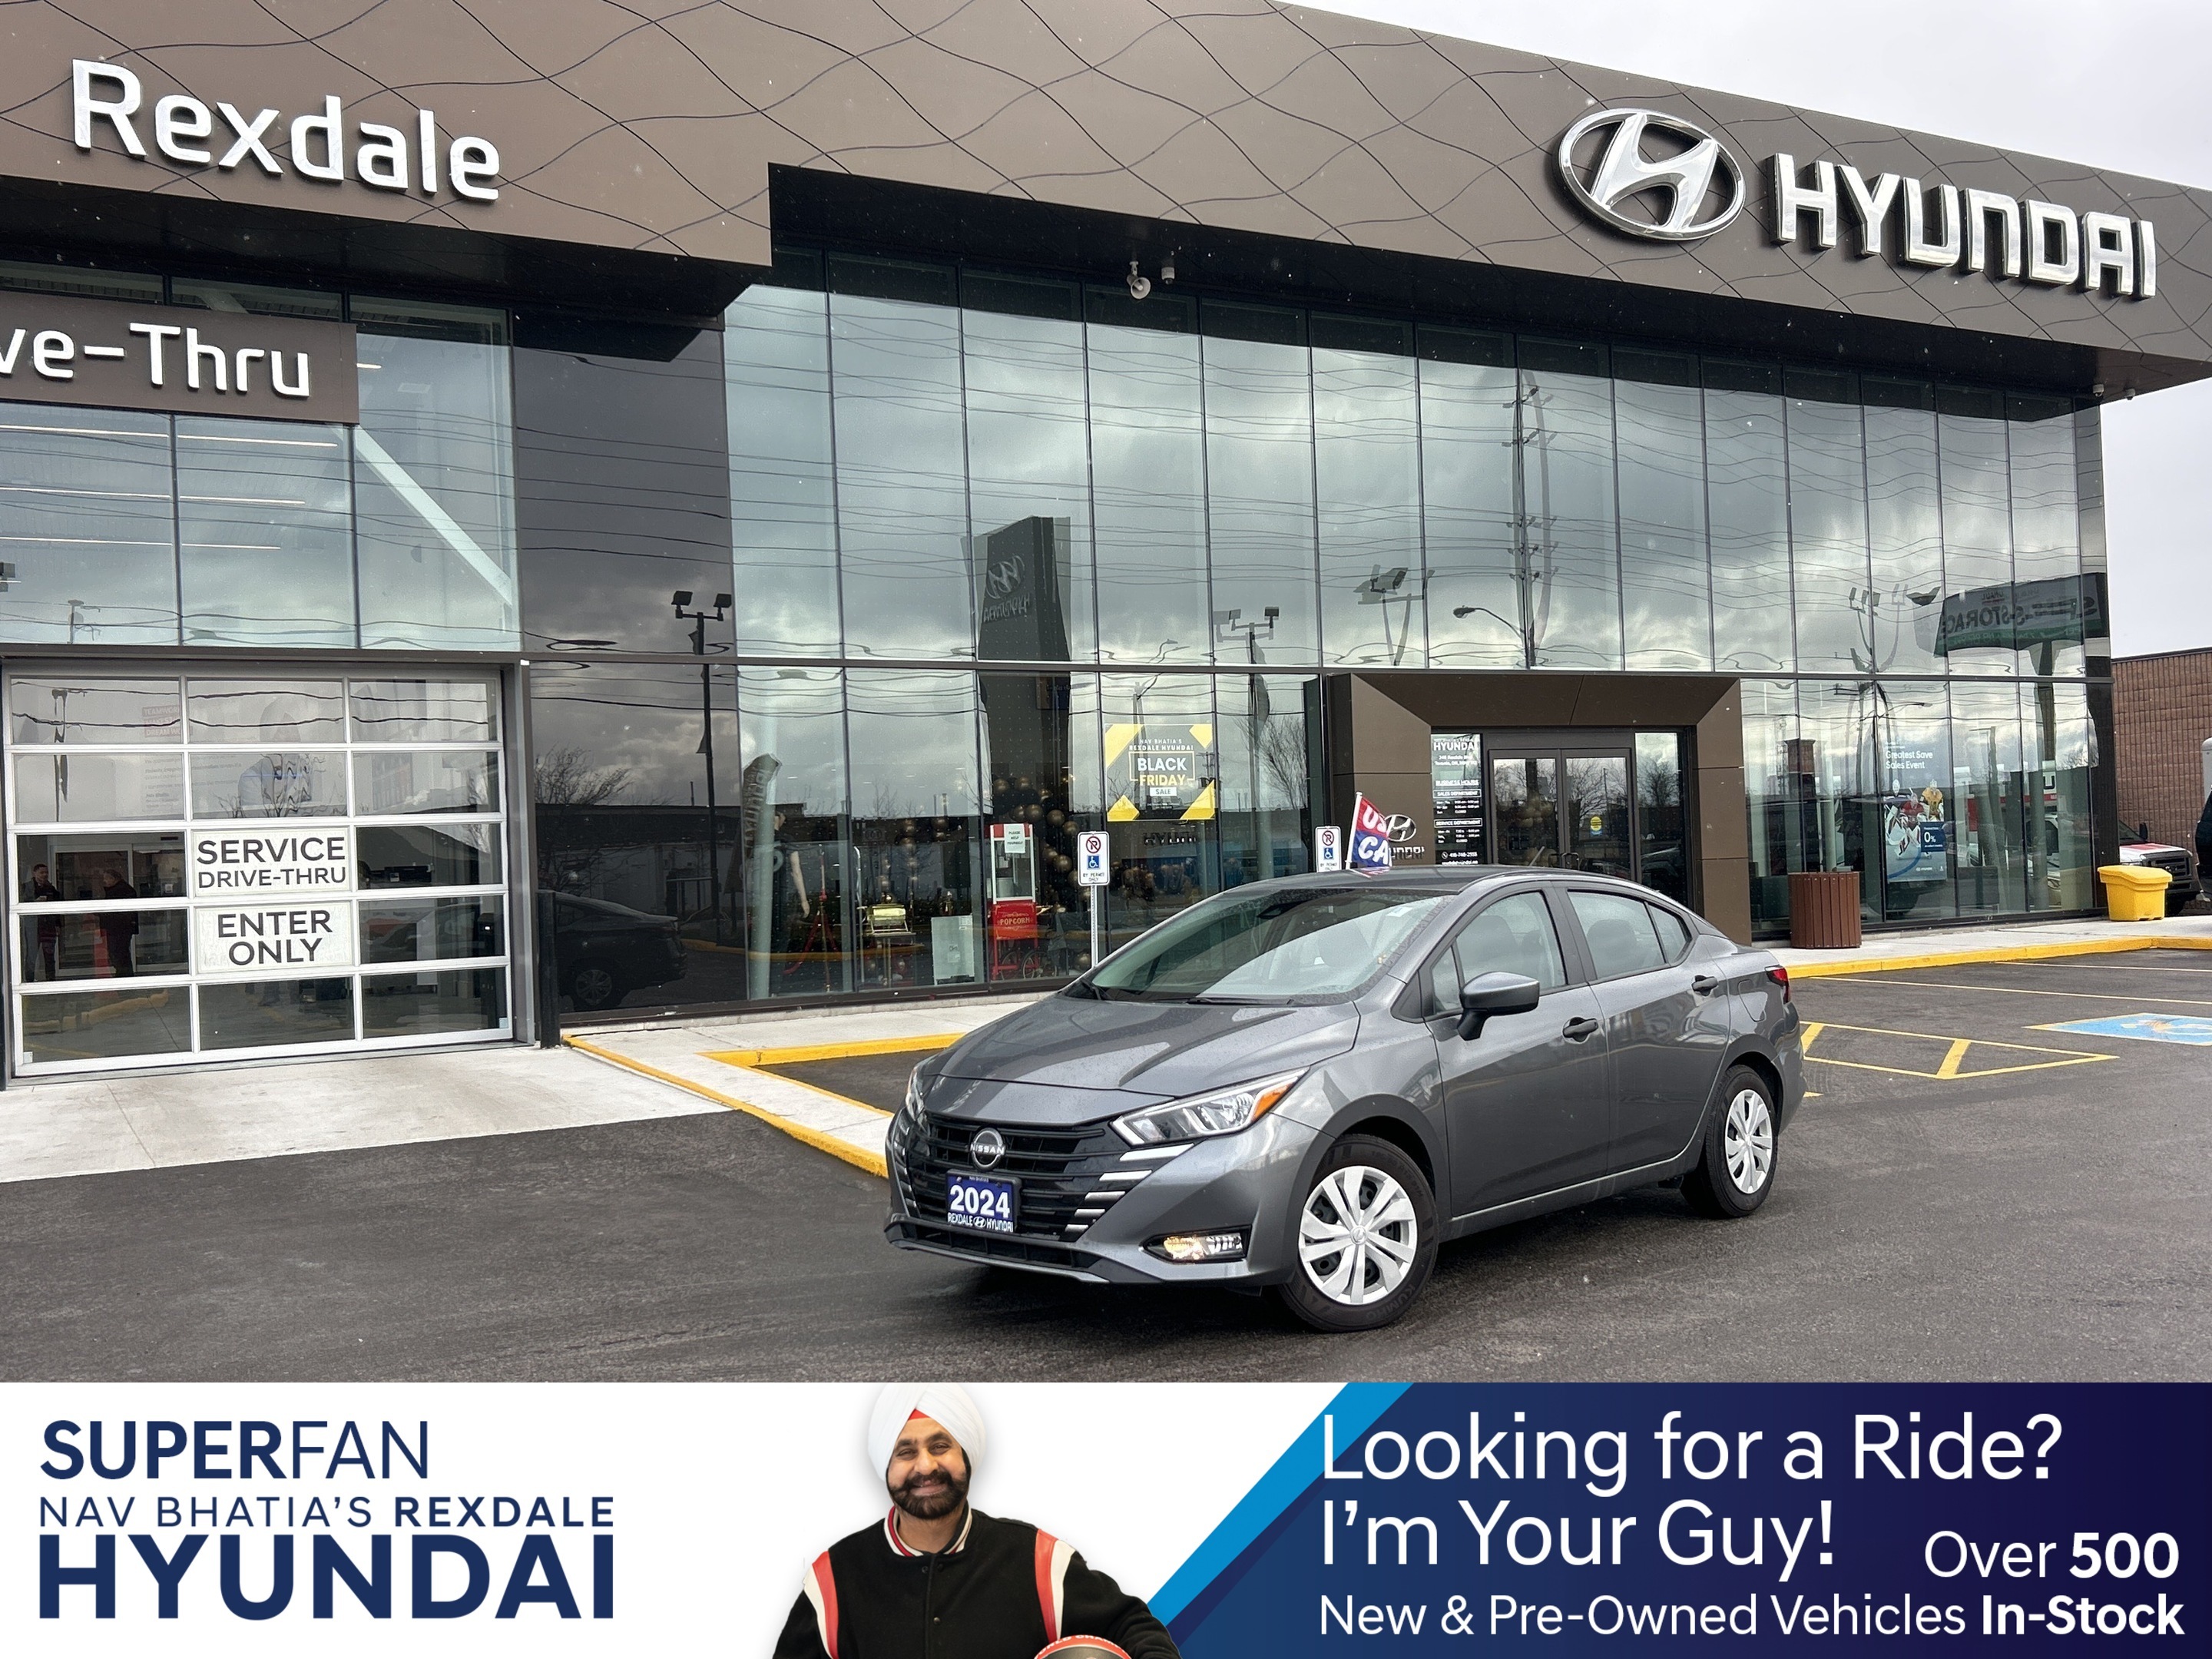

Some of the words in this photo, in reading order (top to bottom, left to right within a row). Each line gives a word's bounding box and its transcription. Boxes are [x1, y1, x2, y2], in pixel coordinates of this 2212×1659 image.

[72, 58, 502, 201] Rexdale
[1772, 153, 2155, 300] HYUNDAI
[1433, 742, 1479, 751] HYUNDA
[1886, 750, 1916, 759] Greatest
[1916, 750, 1933, 759] Save
[1137, 757, 1187, 771] BLACK
[1886, 760, 1905, 769] Sales
[1906, 760, 1926, 769] Event
[1139, 773, 1186, 786] FRIDAY
[197, 836, 346, 865] SERVICE
[198, 866, 346, 889] DRIVE-THRU
[217, 909, 333, 939] ENTER
[999, 916, 1030, 926] POPCORN
[228, 937, 323, 966] ONLY
[970, 1143, 1005, 1155] NISSAN
[949, 1184, 1011, 1218] 2024
[947, 1212, 973, 1227] REXDALE
[986, 1217, 1014, 1233] HYUNDAI
